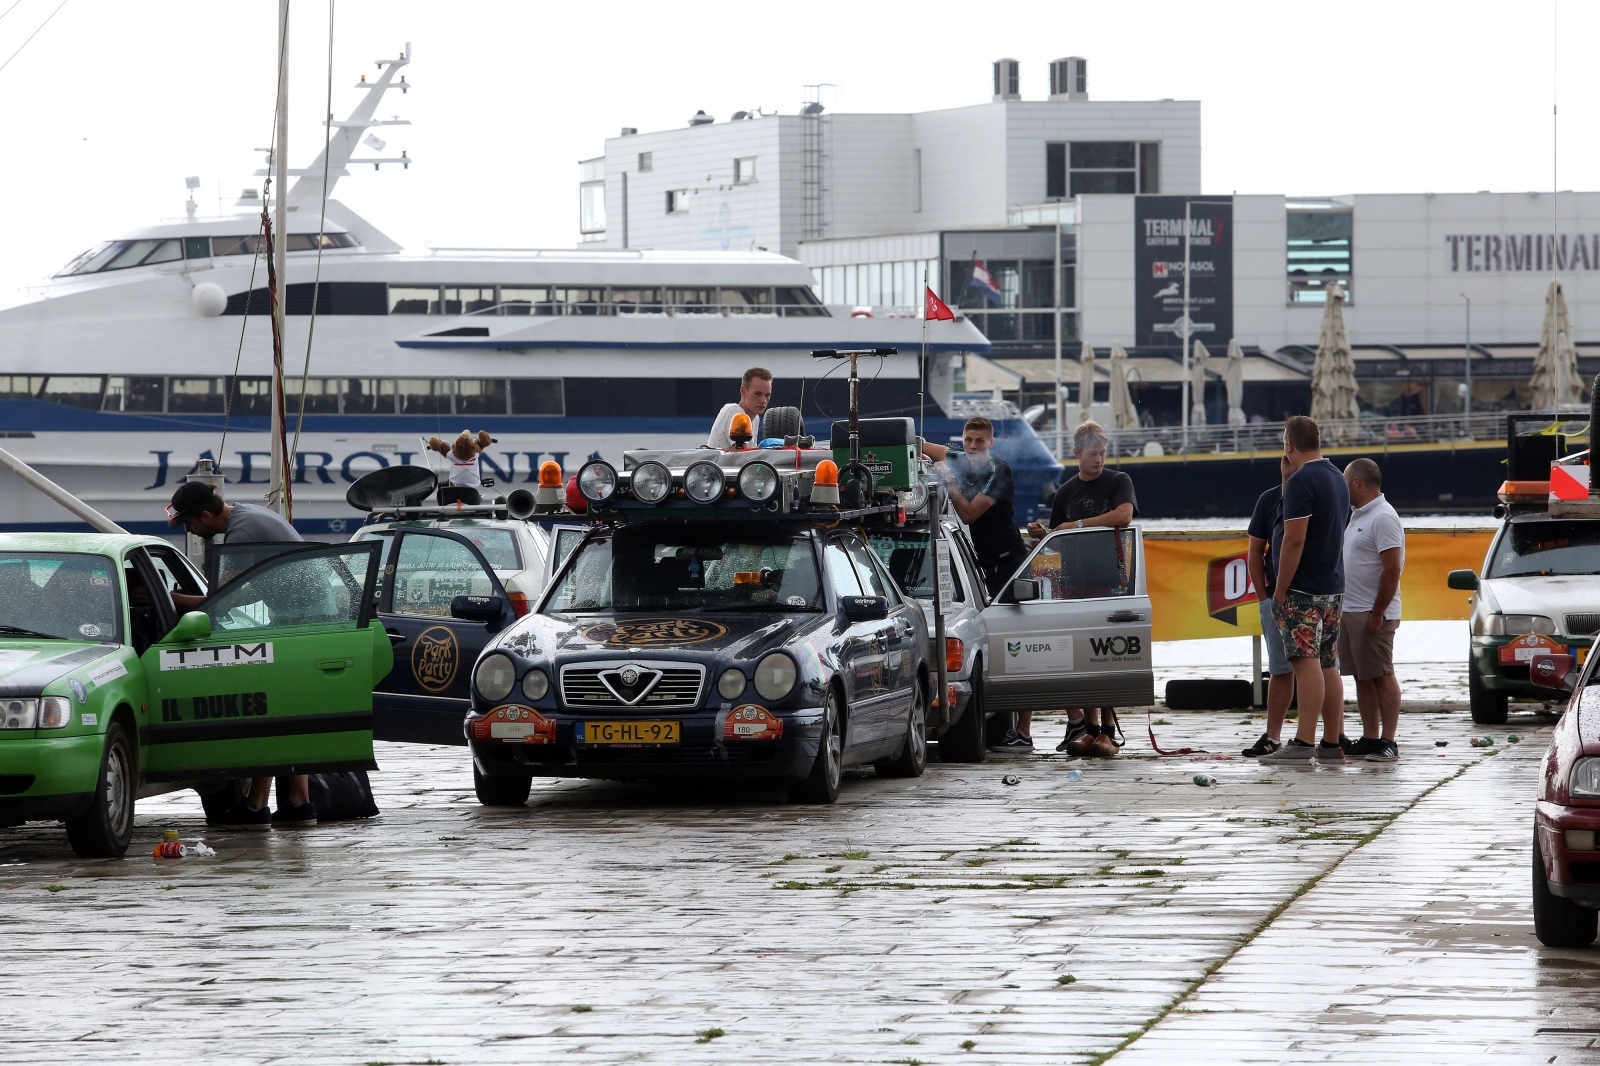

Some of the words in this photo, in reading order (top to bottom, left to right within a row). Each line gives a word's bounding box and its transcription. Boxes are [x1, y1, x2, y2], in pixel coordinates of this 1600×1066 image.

[1143, 219, 1214, 236] TERMINAL
[144, 450, 605, 490] JADRONI
[166, 643, 267, 664] TTM
[1025, 644, 1052, 653] VEPA
[1089, 636, 1142, 656] WOB
[162, 699, 181, 722] IL
[194, 691, 268, 720] DUKES
[590, 724, 674, 740] TG-HL-92
